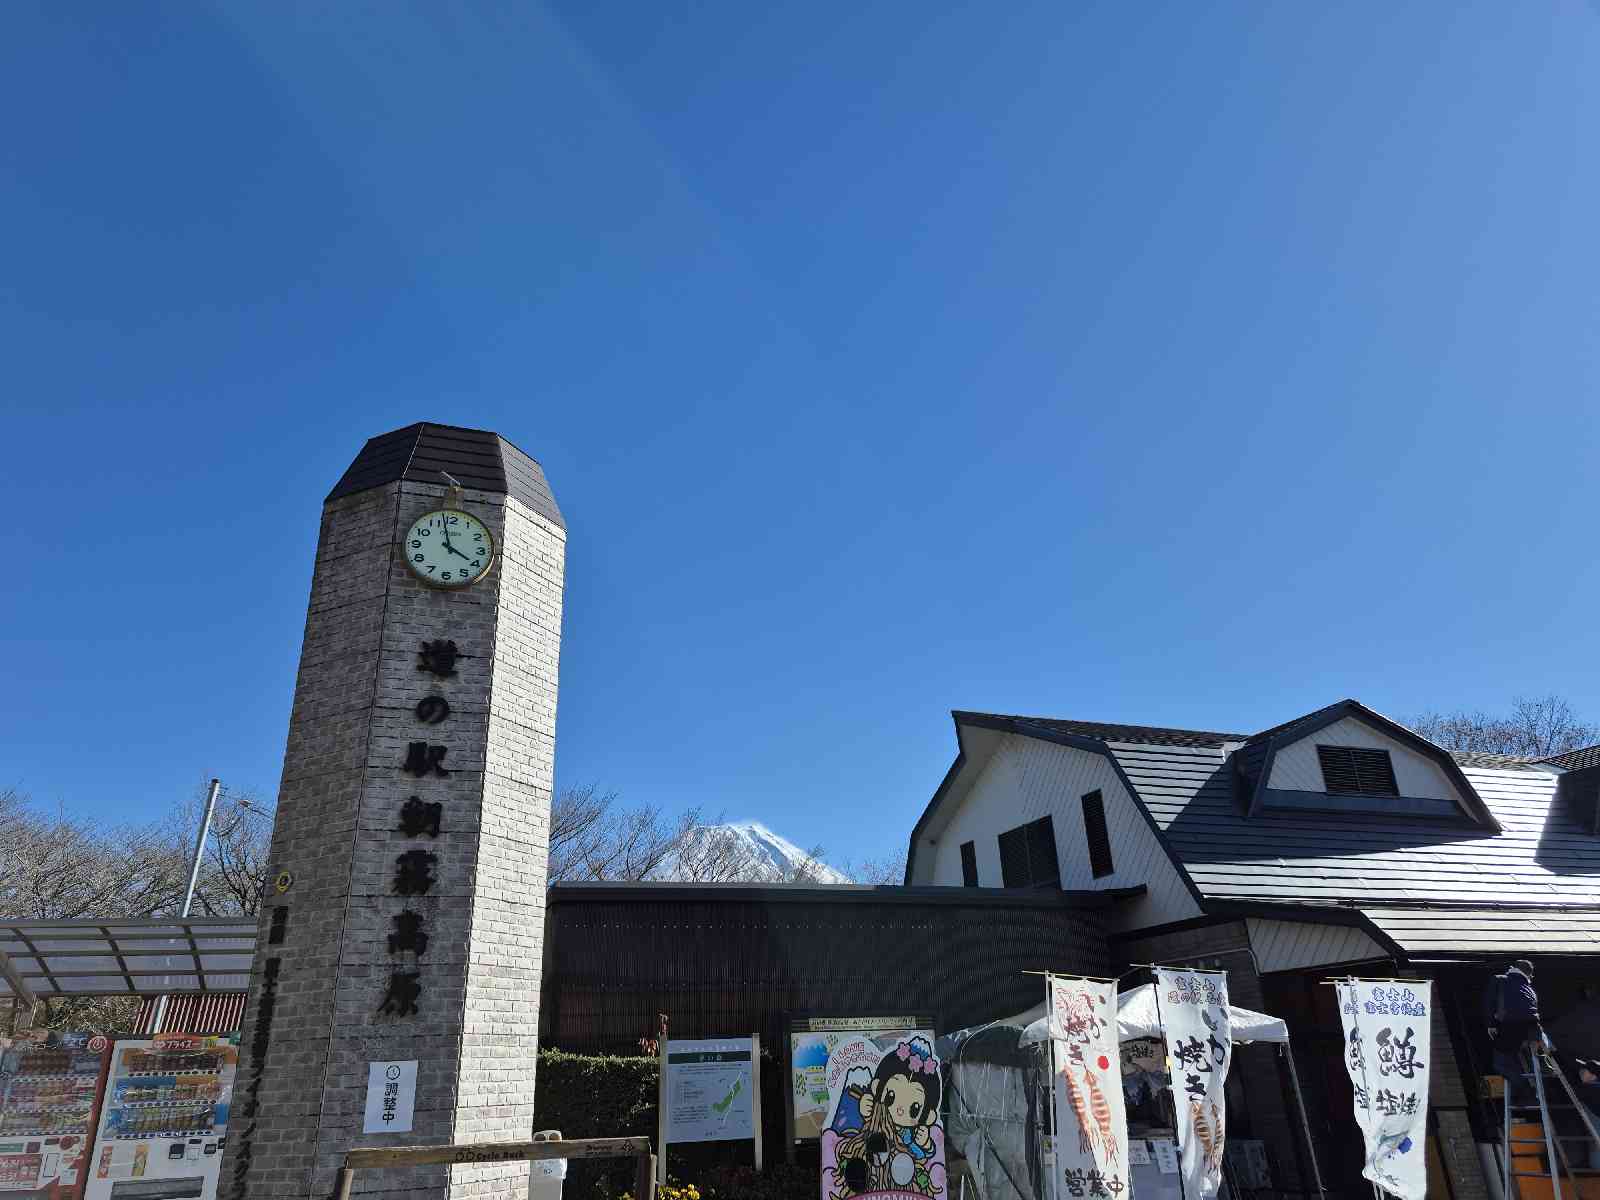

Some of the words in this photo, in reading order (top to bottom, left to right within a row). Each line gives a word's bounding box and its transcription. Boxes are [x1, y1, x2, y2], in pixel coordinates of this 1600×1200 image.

[429, 520, 440, 528] 11
[446, 516, 458, 525] 12
[417, 528, 431, 536] 10
[473, 533, 482, 541] 2
[411, 539, 422, 548] 9
[476, 546, 486, 556] 3
[414, 553, 425, 562] 8
[470, 559, 481, 568] 4
[426, 565, 436, 573] 7
[459, 568, 469, 578] 5
[441, 571, 452, 580] 6
[1064, 1168, 1124, 1198] 営業中
